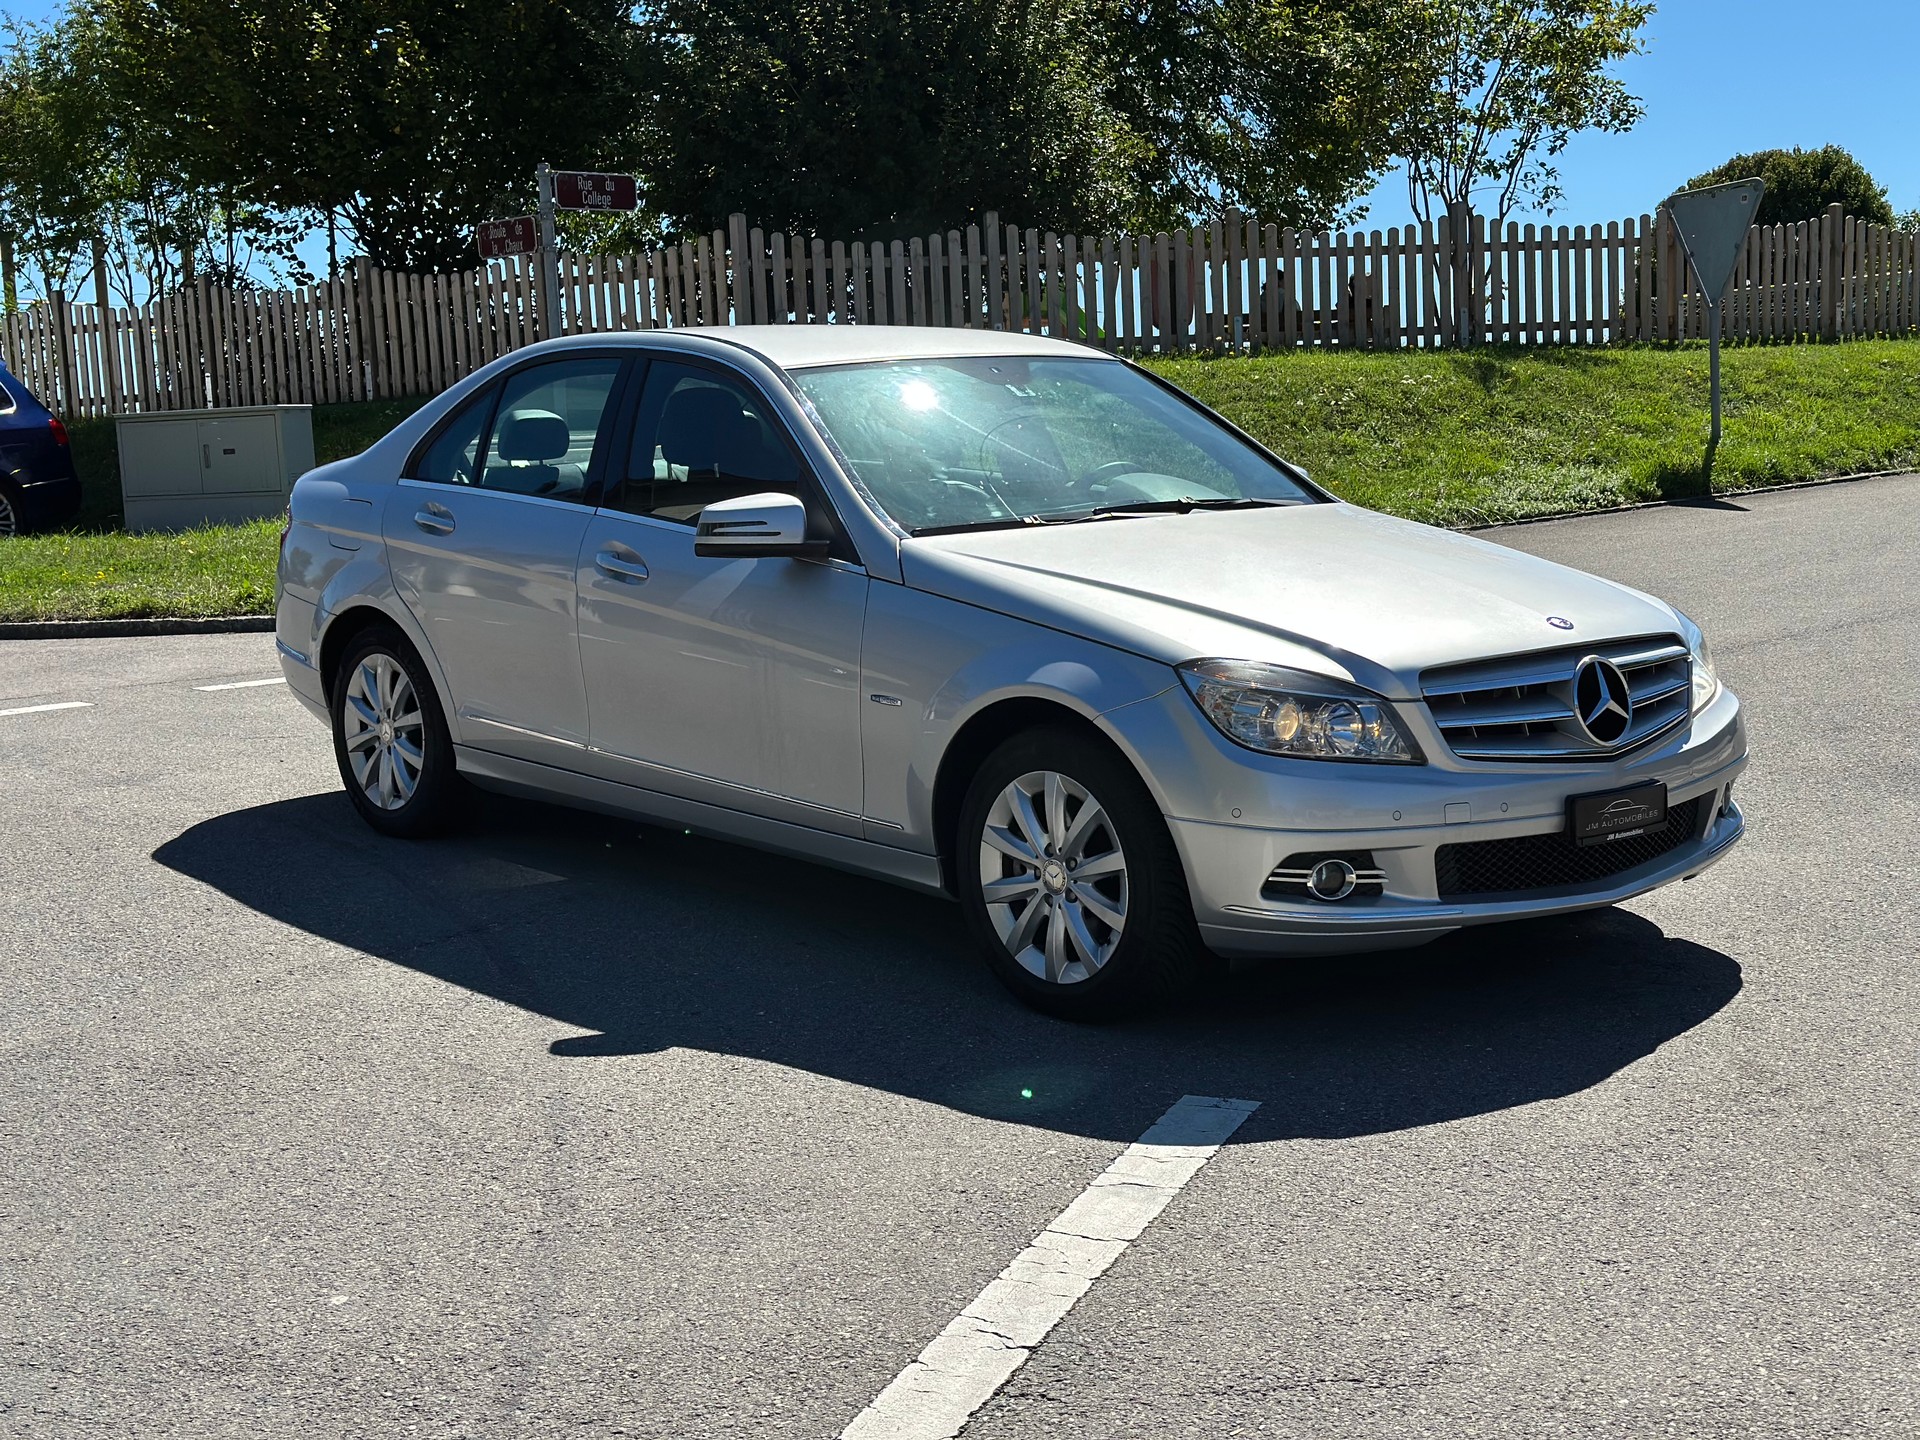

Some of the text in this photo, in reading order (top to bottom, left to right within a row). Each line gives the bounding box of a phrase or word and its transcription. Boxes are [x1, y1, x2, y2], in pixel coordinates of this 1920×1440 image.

[577, 175, 615, 191] Rue du
[582, 190, 612, 208] Collège
[490, 220, 523, 239] Route de
[492, 239, 524, 254] la Chaux
[1585, 809, 1658, 831] JM AUTOMOBILES
[1615, 828, 1644, 838] Automobiles
